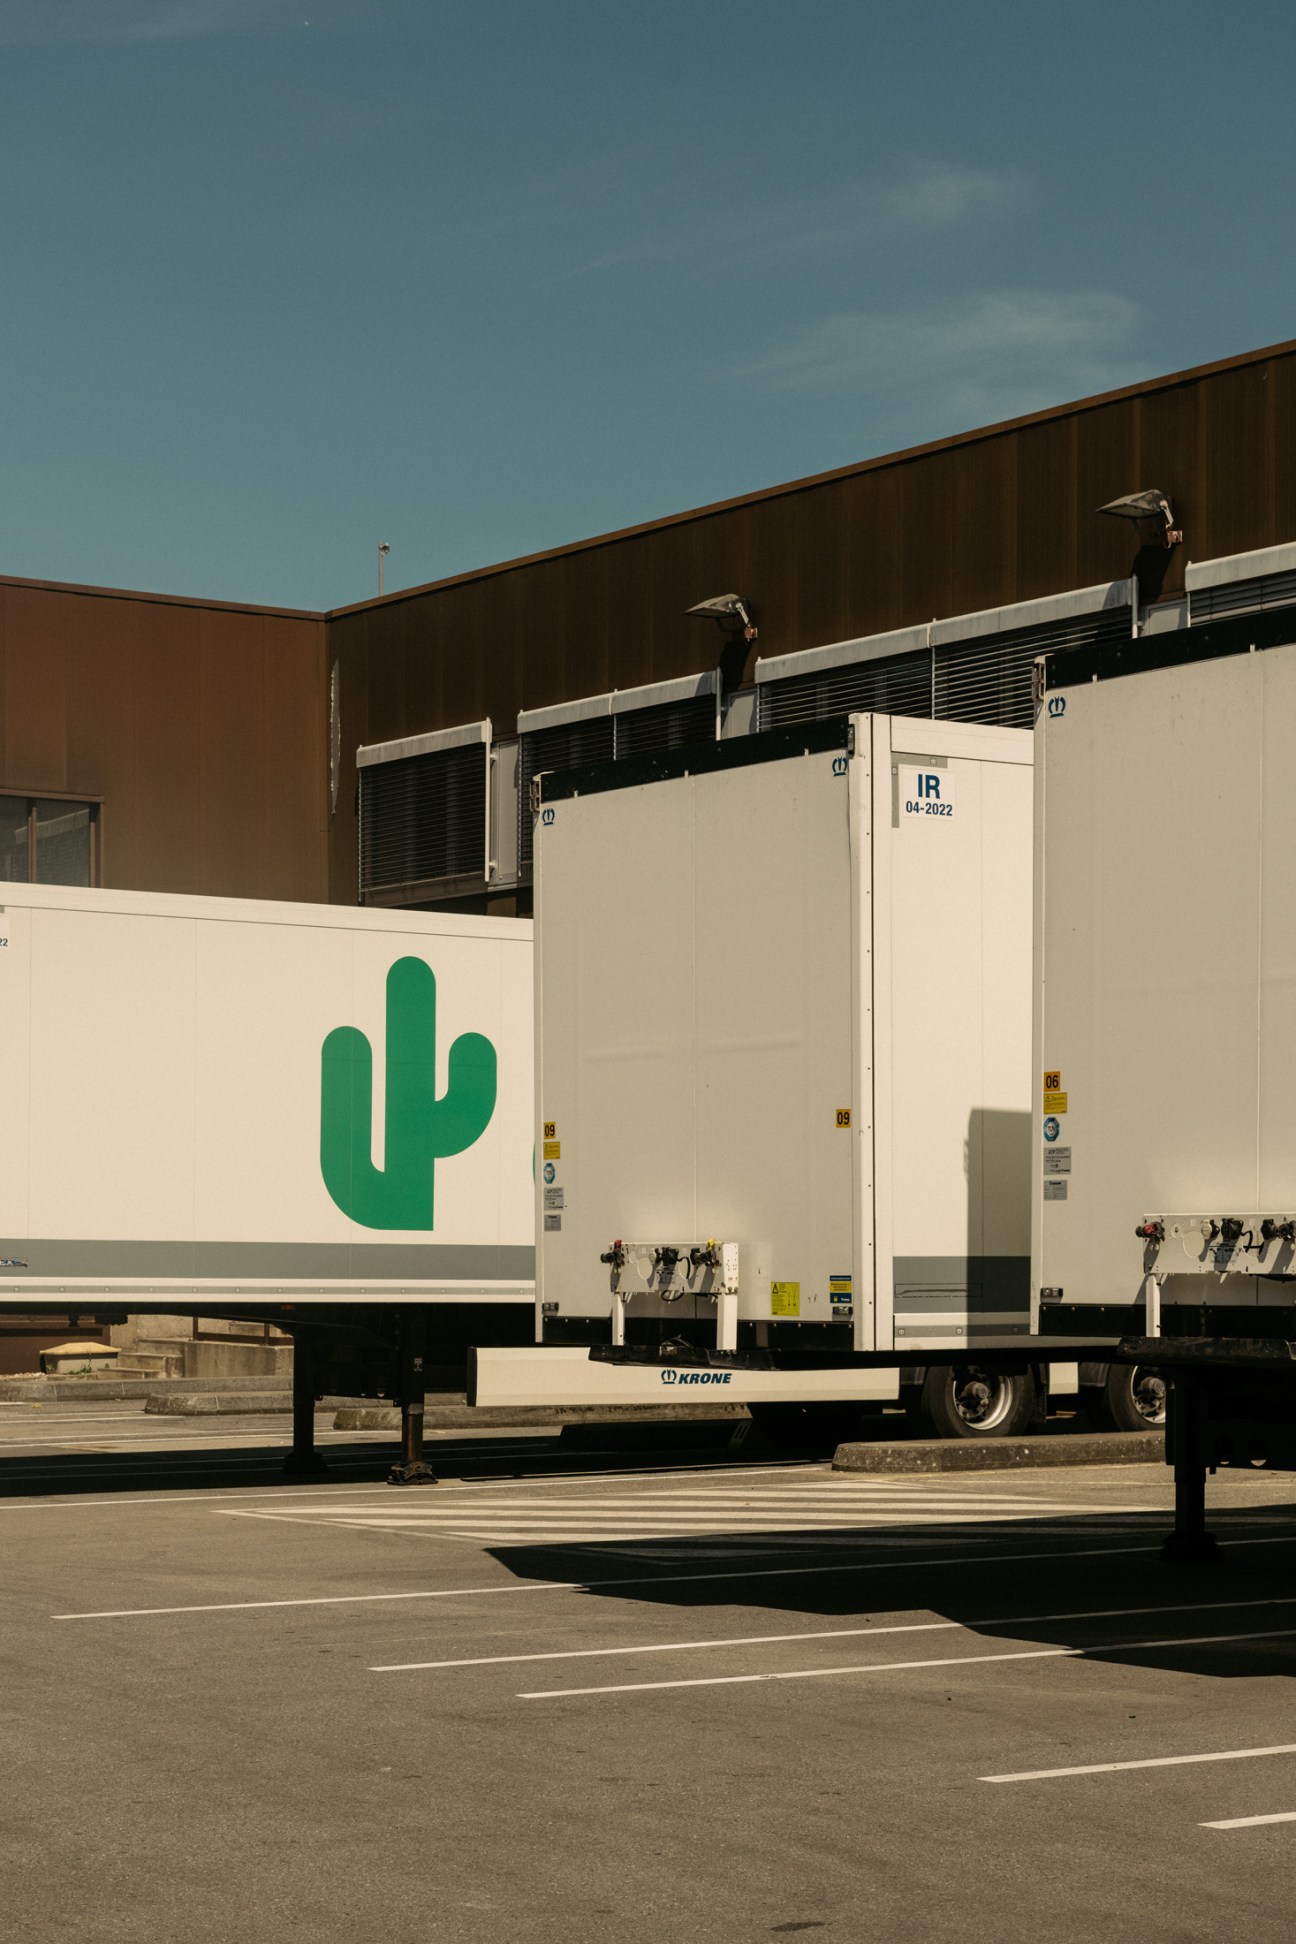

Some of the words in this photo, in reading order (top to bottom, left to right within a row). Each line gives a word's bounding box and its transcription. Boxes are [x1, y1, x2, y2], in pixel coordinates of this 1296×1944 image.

[918, 774, 941, 799] IR
[905, 800, 953, 817] 04-2022
[1045, 1074, 1059, 1089] 06
[837, 1111, 850, 1125] 09
[544, 1124, 555, 1137] 09
[678, 1373, 732, 1384] KRONE
